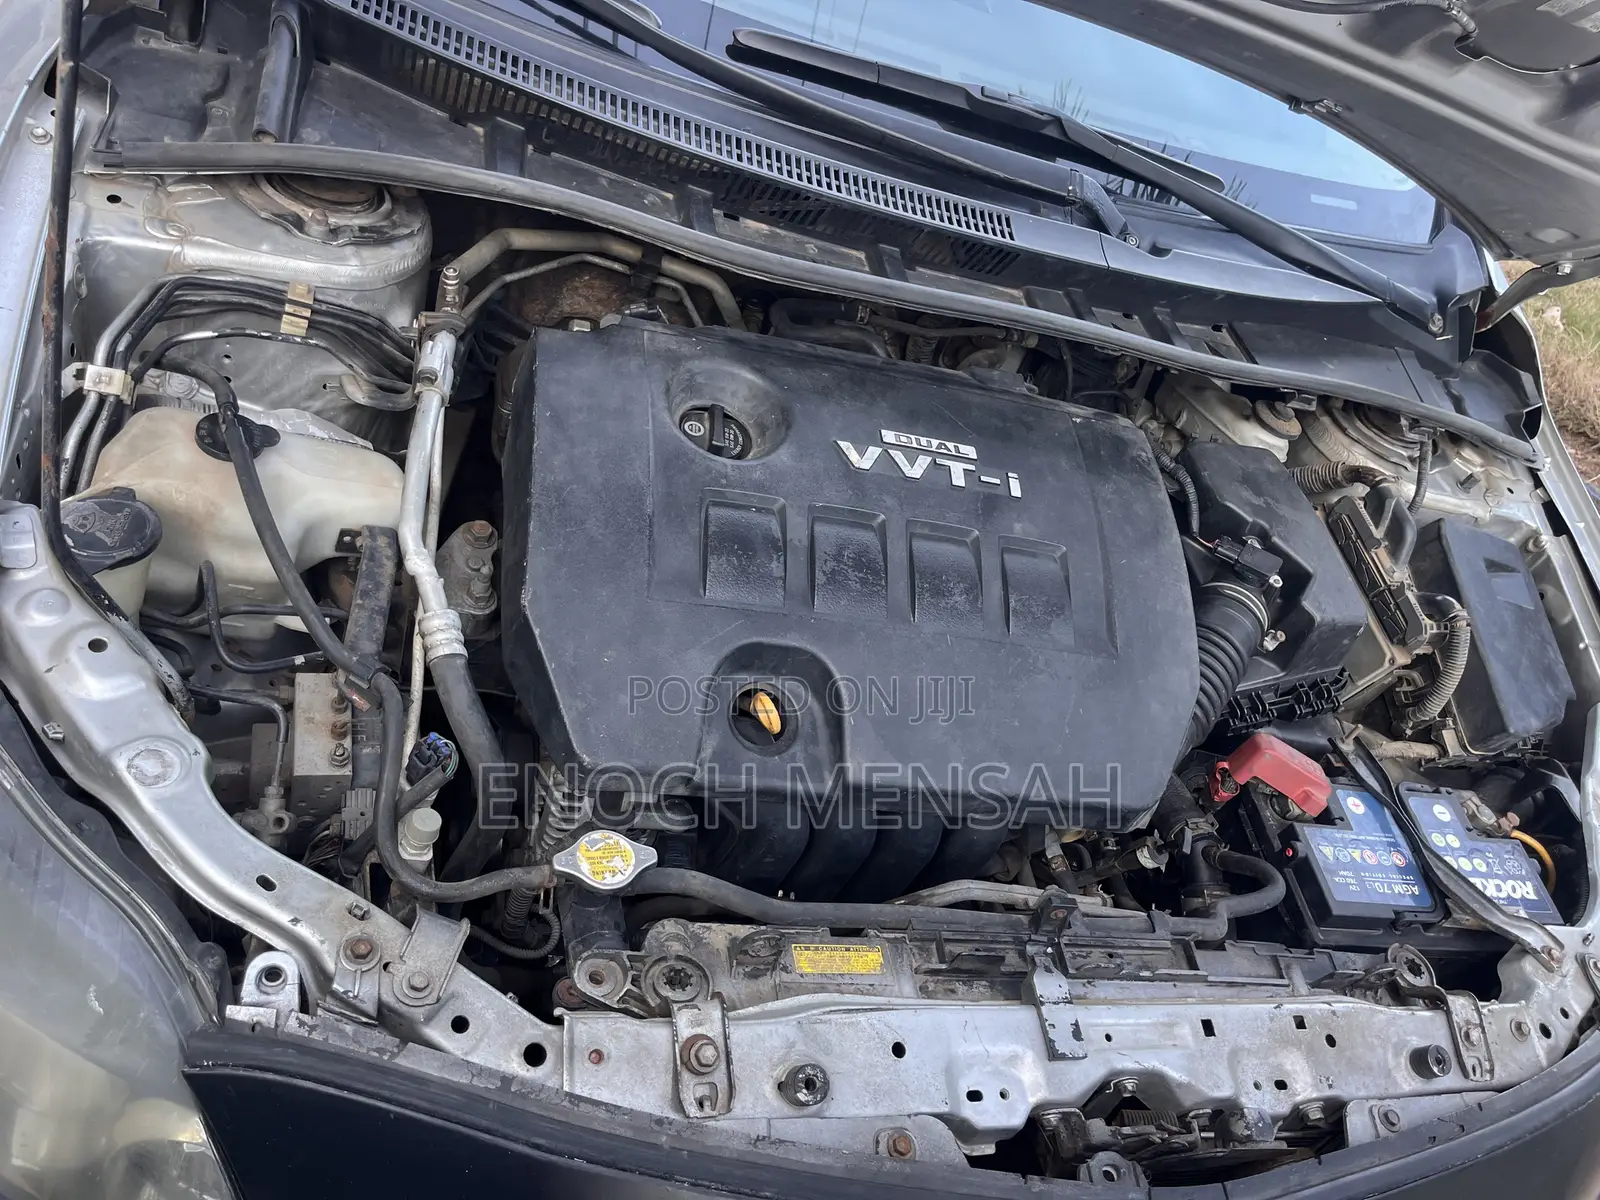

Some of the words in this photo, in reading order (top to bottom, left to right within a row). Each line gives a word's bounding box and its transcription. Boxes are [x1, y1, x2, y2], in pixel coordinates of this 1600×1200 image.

[893, 432, 970, 456] DUAL
[834, 439, 1022, 498] VVT-i
[1391, 883, 1419, 895] AGM
